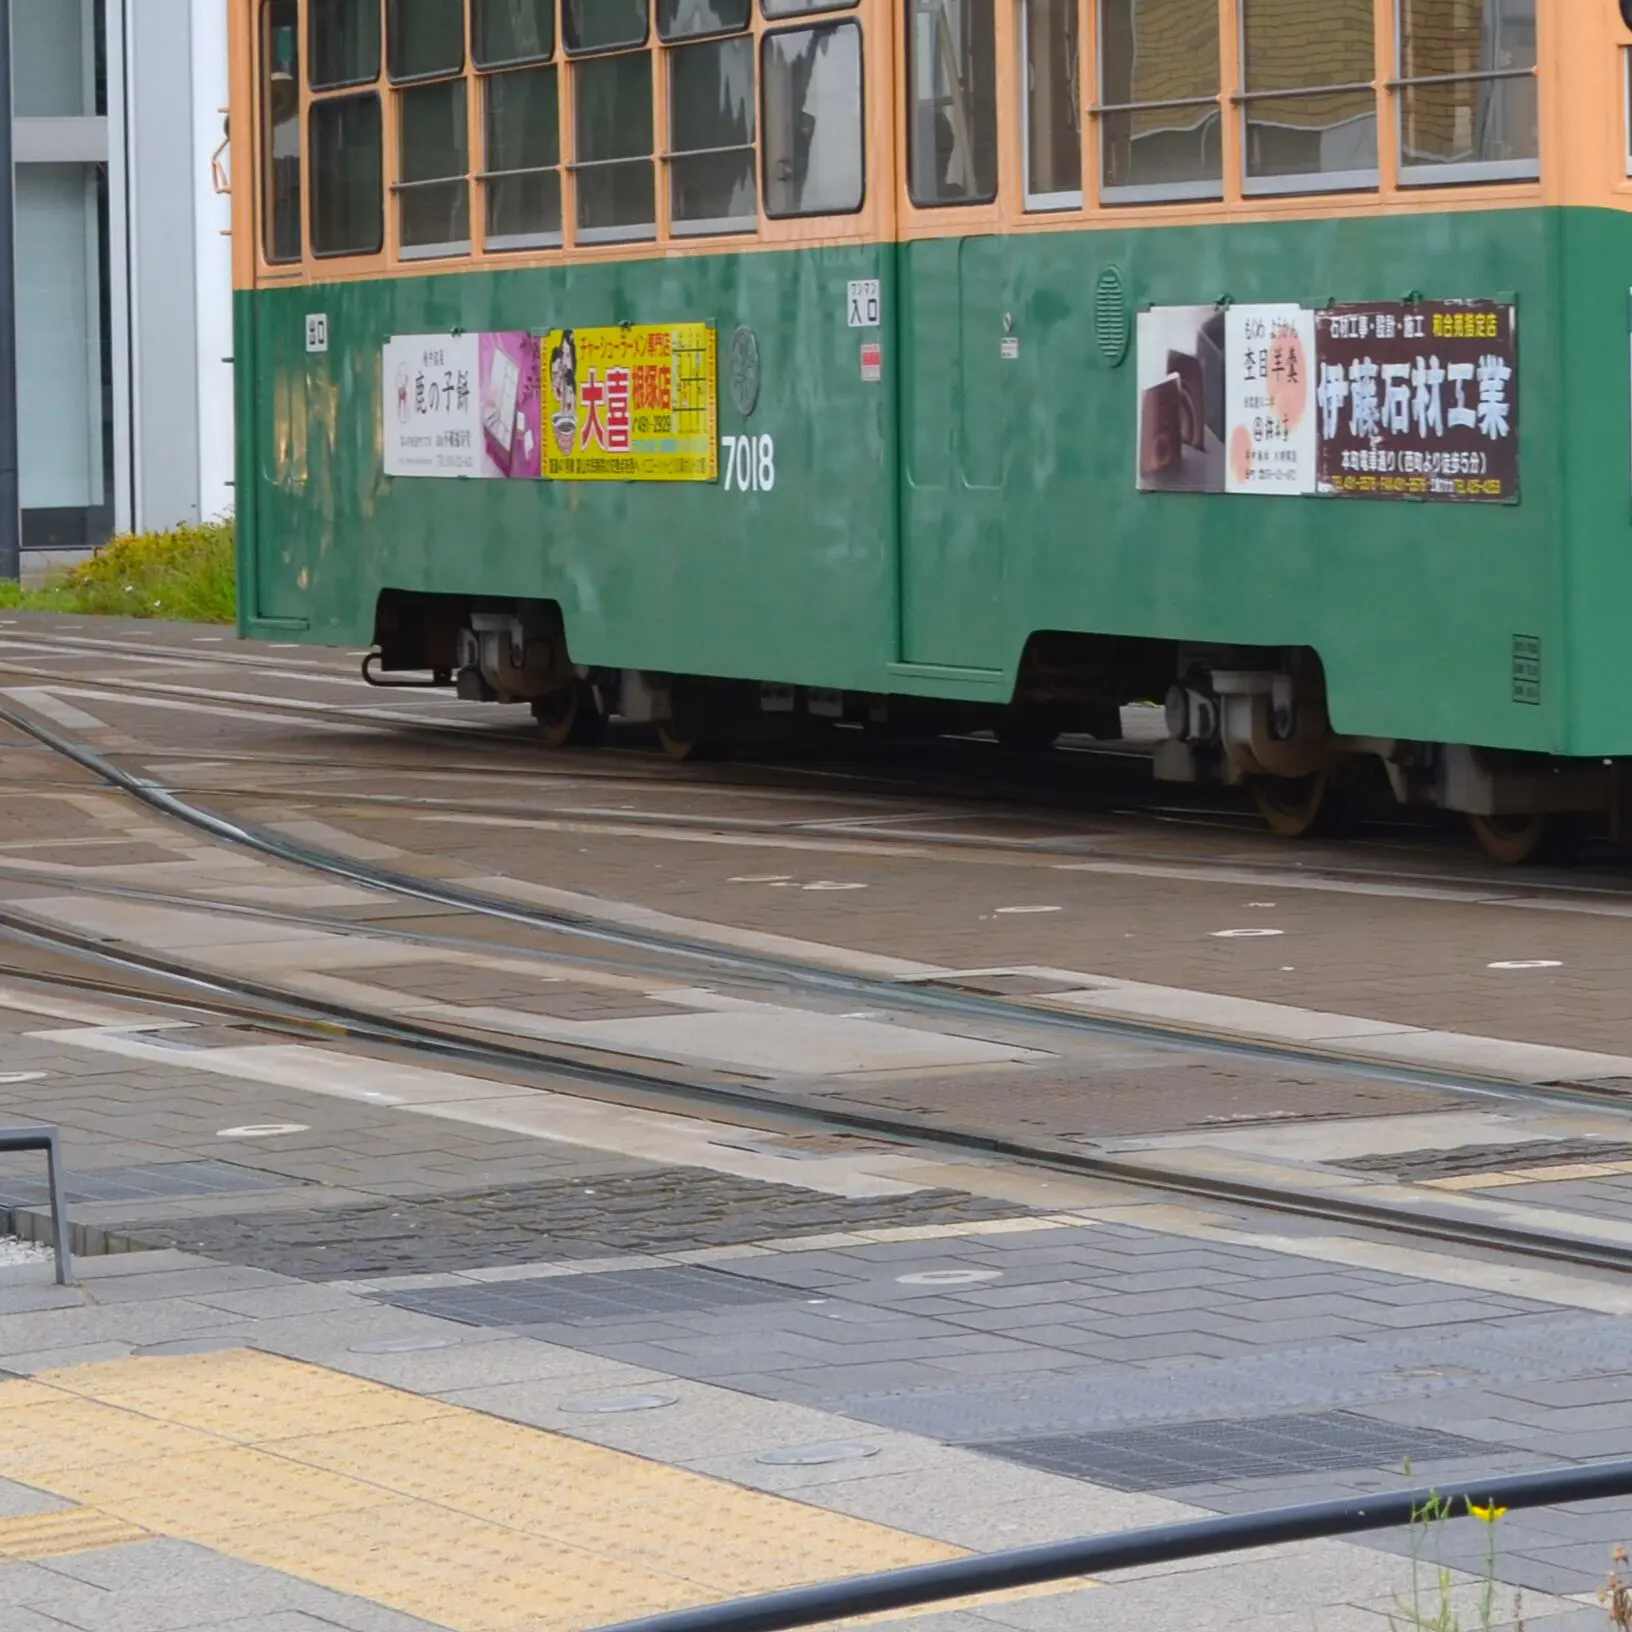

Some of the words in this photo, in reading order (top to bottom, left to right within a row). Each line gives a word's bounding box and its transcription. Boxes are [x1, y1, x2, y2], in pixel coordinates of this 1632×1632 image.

[850, 298, 877, 324] 入口
[580, 366, 630, 452] 大喜
[1317, 355, 1511, 440] 伊藤石材工業
[721, 434, 774, 492] 7018
